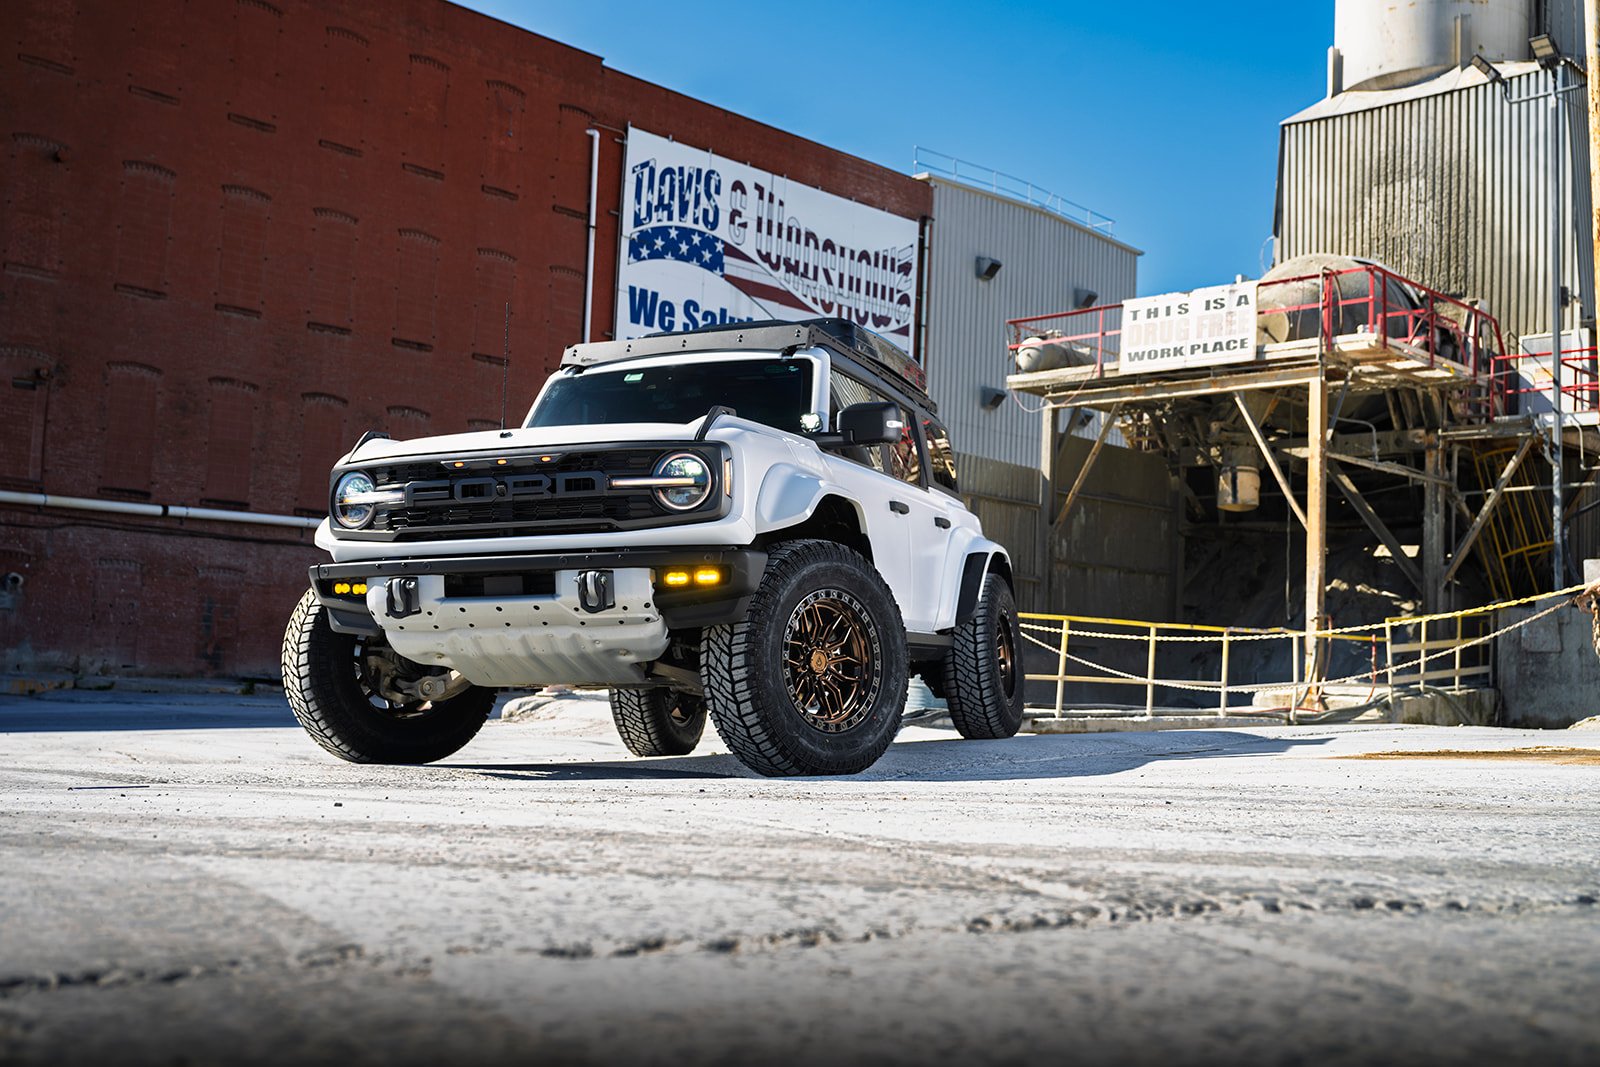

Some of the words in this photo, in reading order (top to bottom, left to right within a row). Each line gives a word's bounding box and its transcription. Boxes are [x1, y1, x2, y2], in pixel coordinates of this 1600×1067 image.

[632, 158, 721, 231] DAVIS
[729, 180, 748, 245] &
[629, 285, 675, 332] We
[1130, 303, 1189, 321] THIS
[1205, 298, 1226, 311] IS
[1236, 294, 1250, 307] A
[1128, 318, 1189, 347] DRUG
[1196, 310, 1250, 339] FREE
[1127, 345, 1185, 362] WORK
[1189, 337, 1249, 356] PLACE
[405, 470, 605, 507] FORD
